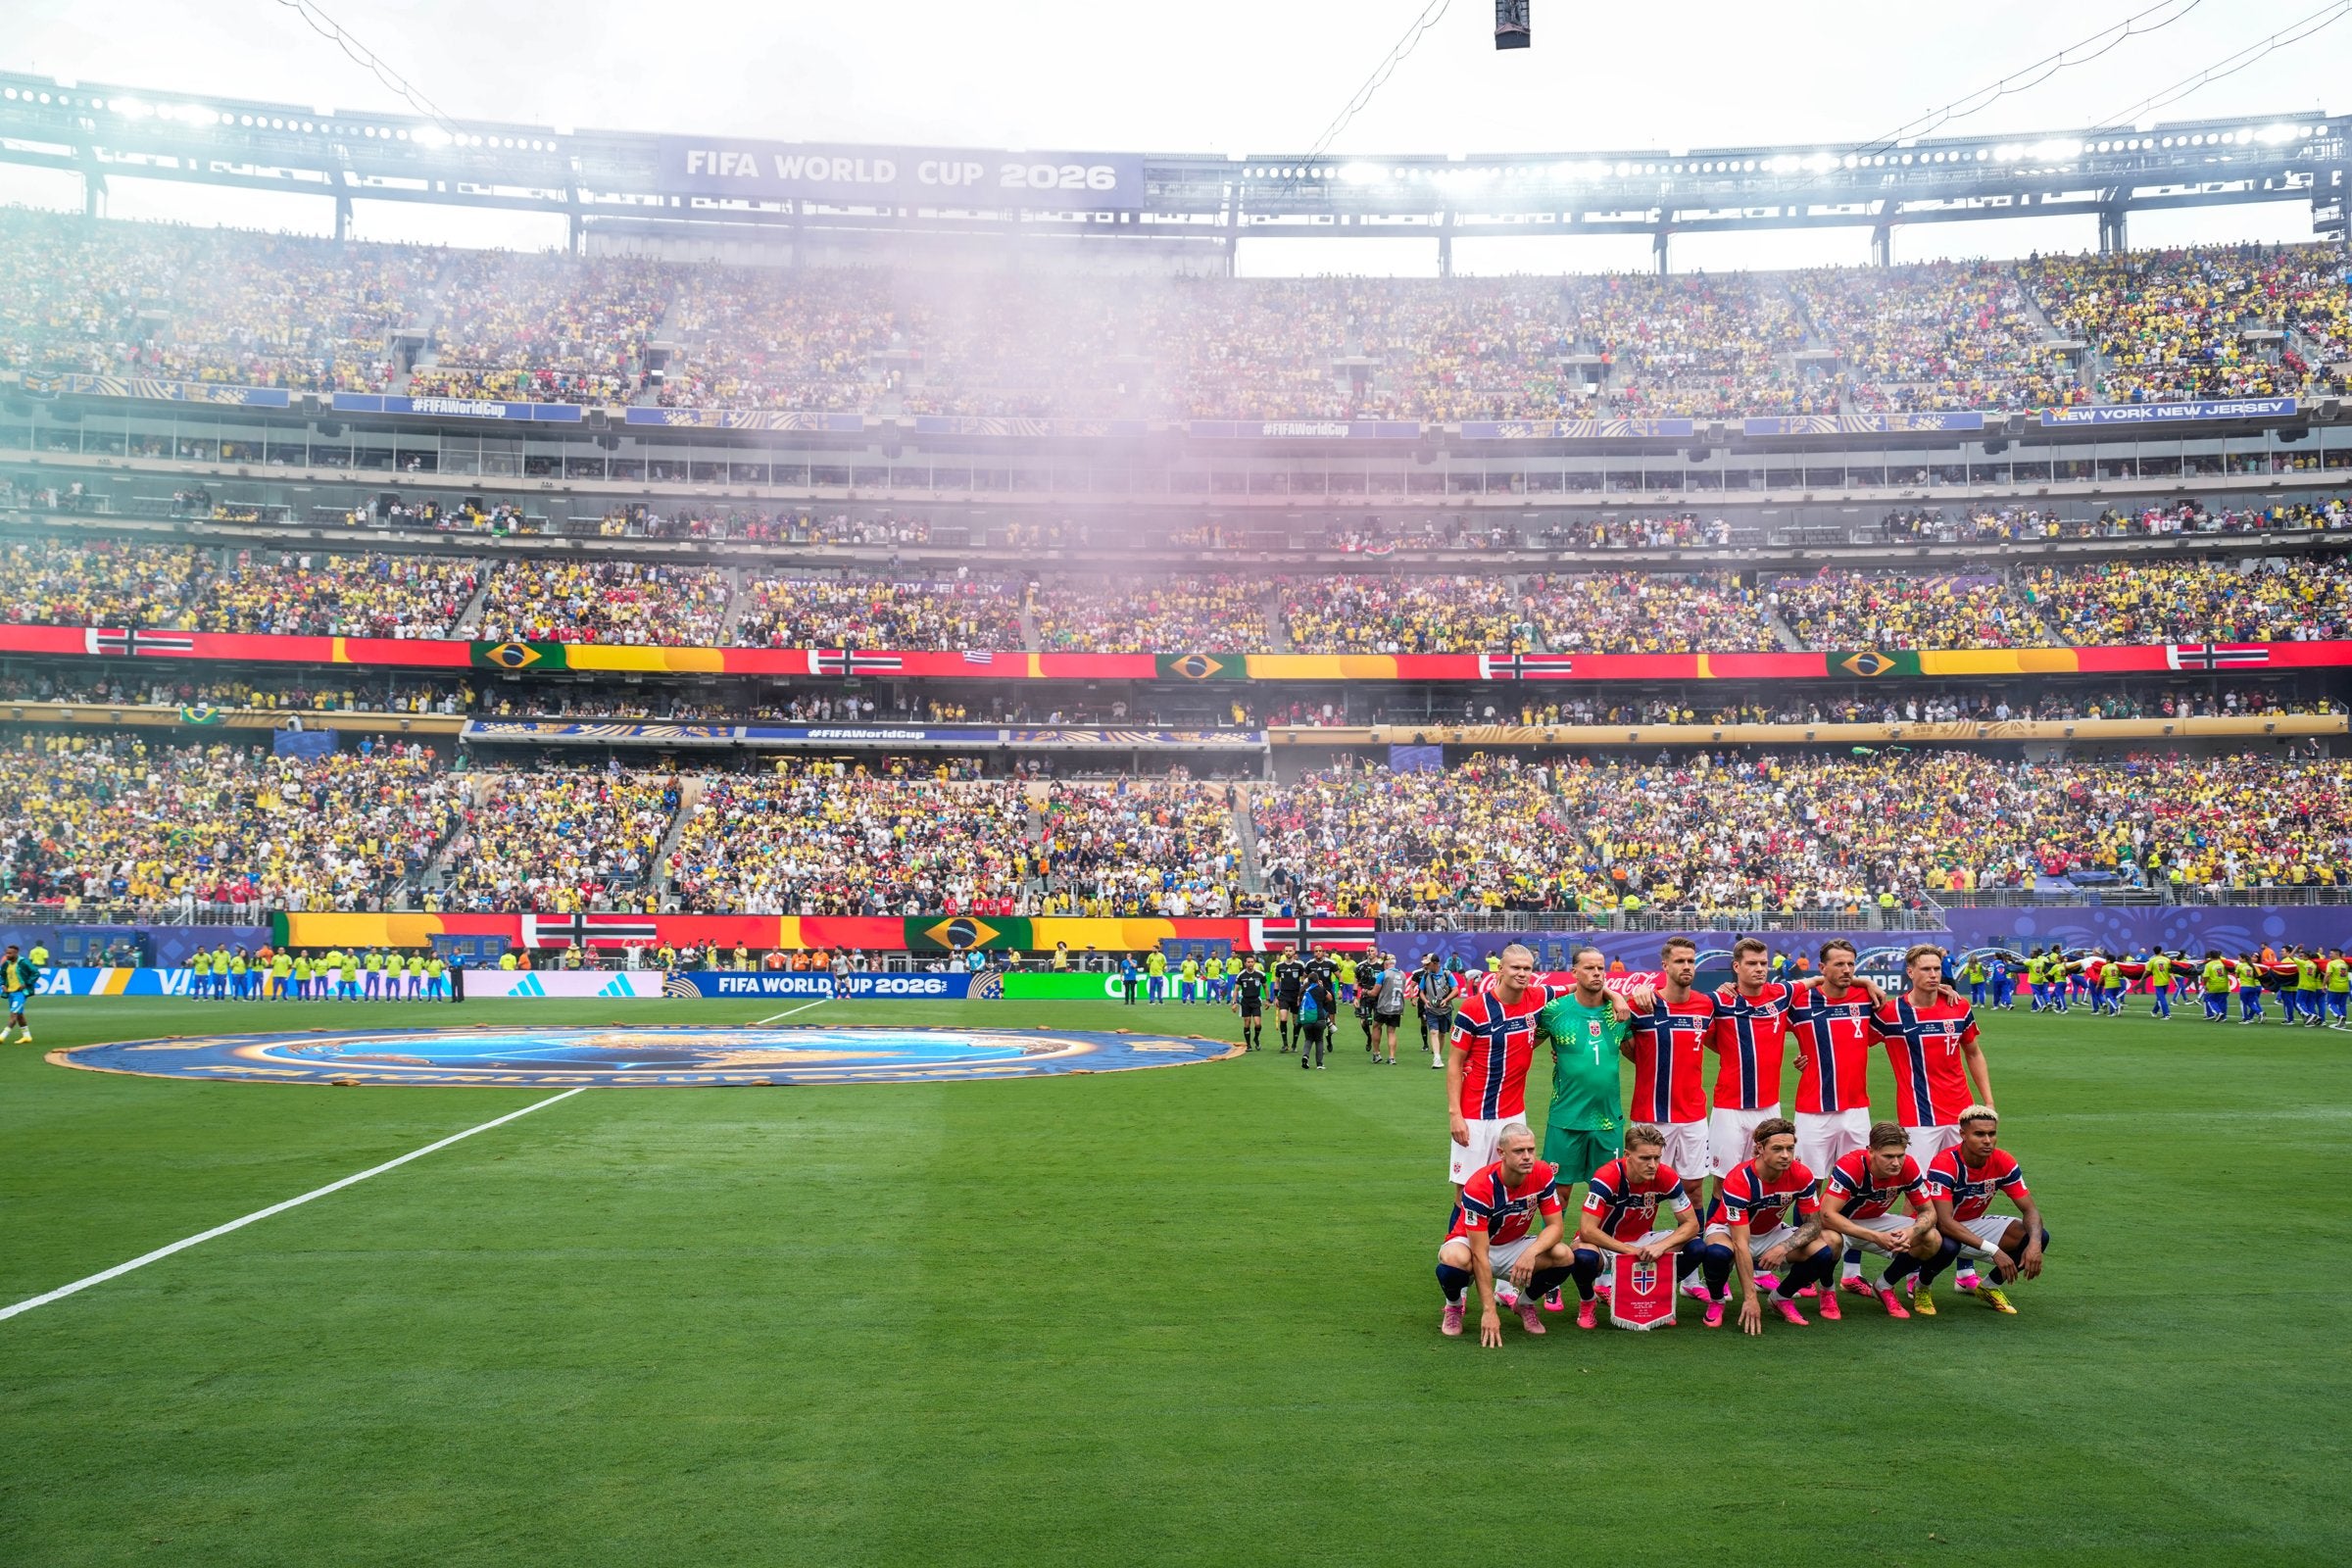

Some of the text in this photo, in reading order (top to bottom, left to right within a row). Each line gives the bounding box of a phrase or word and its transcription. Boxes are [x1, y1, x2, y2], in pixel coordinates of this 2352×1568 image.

[686, 149, 1116, 190] FIFA WORLD CUP 2026
[412, 398, 506, 418] #FIFAWorldCup
[2099, 408, 2153, 419] YORK
[2157, 405, 2202, 416] NEW
[2205, 402, 2283, 415] JERSEY
[1262, 422, 1348, 438] #FIFAWorldCup
[808, 729, 925, 740] #FIFAWorldCup
[34, 968, 80, 995] SA
[718, 978, 760, 993] FIFA
[762, 978, 832, 994] WORLD
[875, 978, 941, 994] 2026
[1851, 1018, 1863, 1039] 8
[1692, 1031, 1702, 1052] 3
[1944, 1035, 1960, 1056] 17
[1592, 1044, 1599, 1066] 1
[319, 1072, 595, 1083] WORLD
[612, 1074, 770, 1083] CUP
